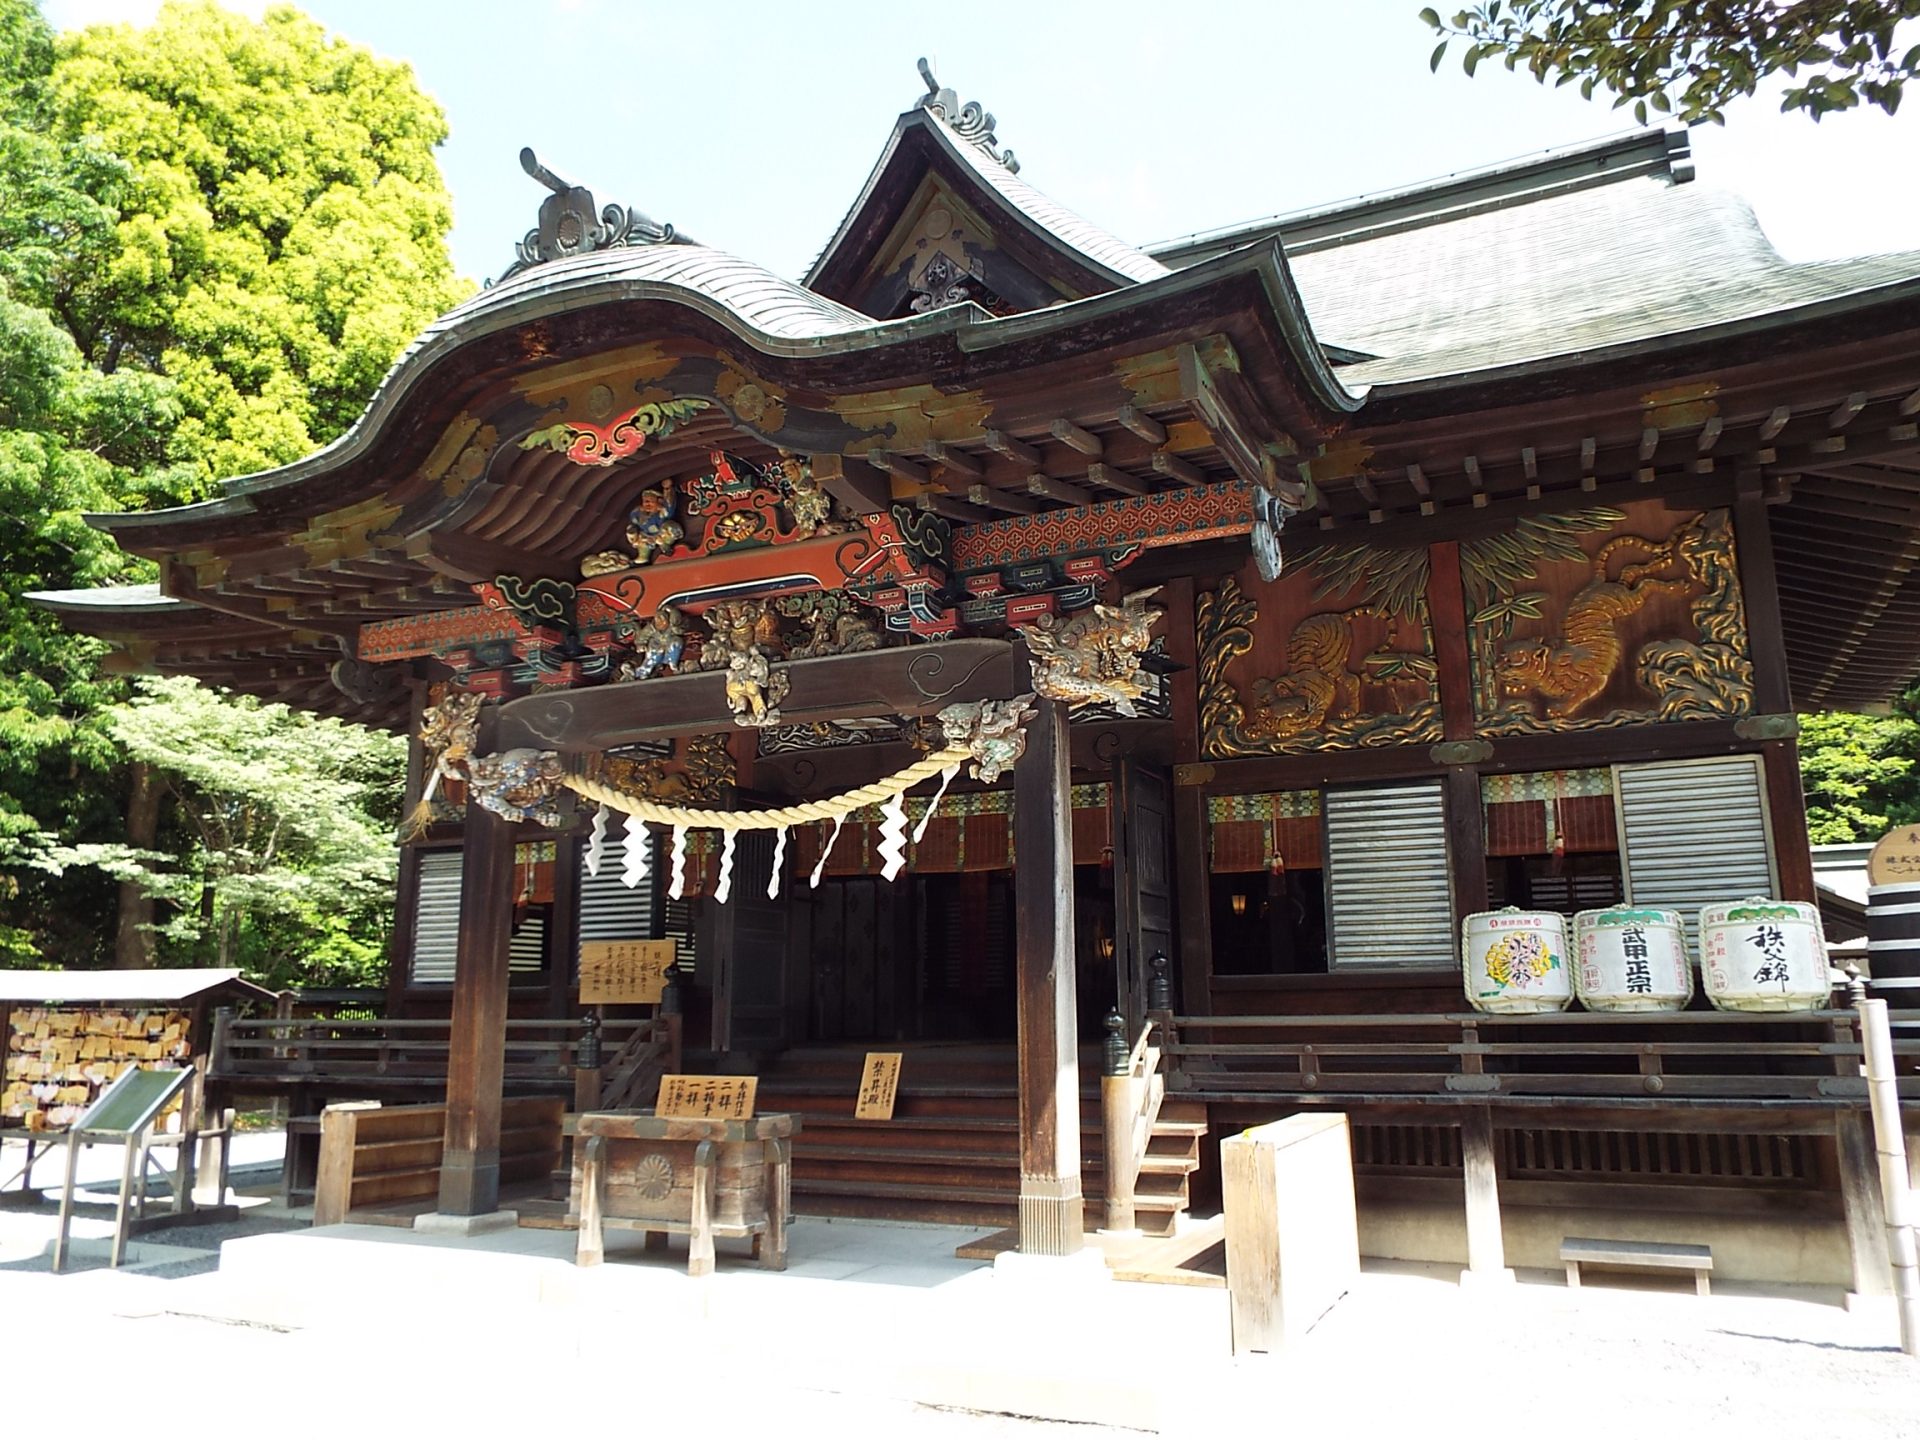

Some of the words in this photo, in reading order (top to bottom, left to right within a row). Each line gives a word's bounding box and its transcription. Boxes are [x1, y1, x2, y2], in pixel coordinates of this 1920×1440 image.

[1621, 927, 1652, 993] 武甲正宗
[1745, 923, 1790, 993] 秩父錦
[703, 1081, 716, 1116] 二拍手
